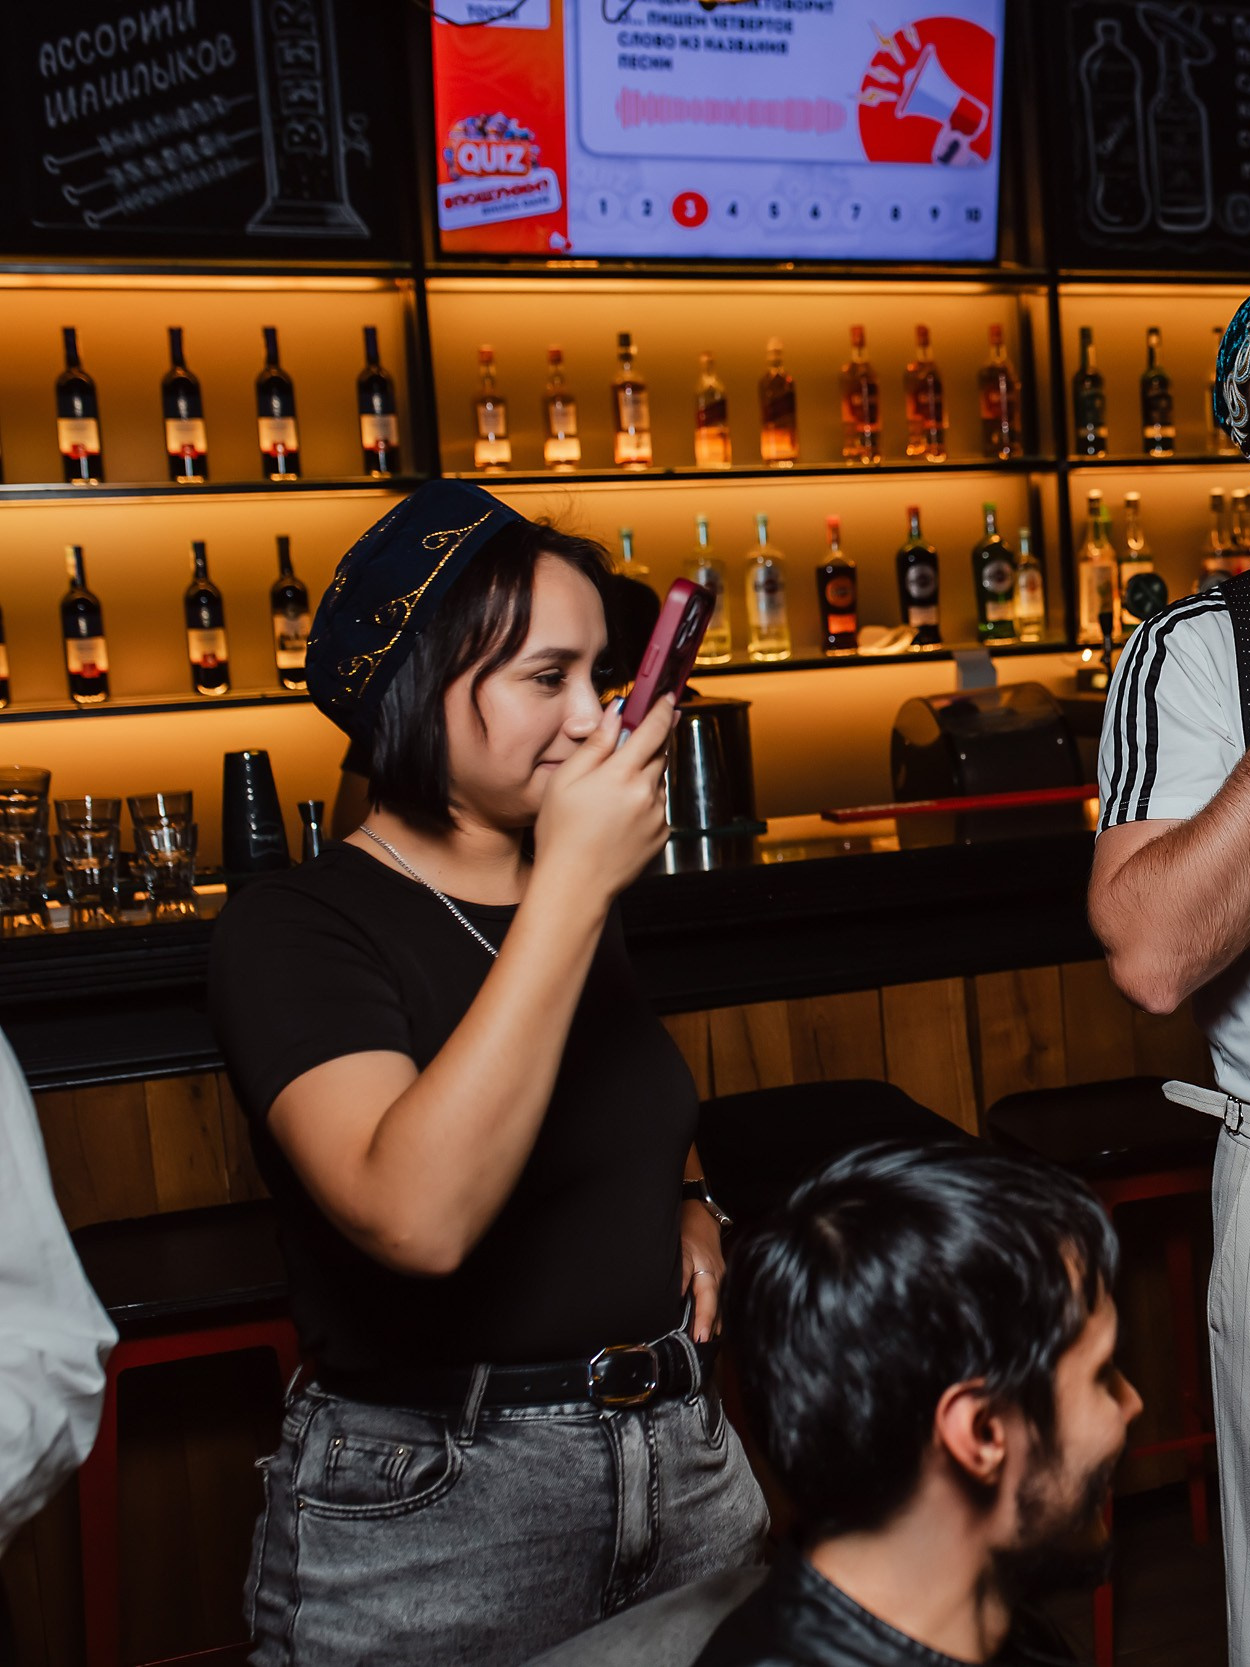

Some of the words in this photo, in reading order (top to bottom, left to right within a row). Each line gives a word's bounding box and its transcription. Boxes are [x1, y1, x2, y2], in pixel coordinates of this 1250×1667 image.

[647, 11, 708, 28] ПИШЕМ
[617, 31, 676, 49] СЛОВО
[679, 35, 700, 51] ИЗ
[618, 54, 673, 71] ПЕСНИ
[44, 33, 236, 128] ШАШЛЫКОВ
[458, 143, 525, 173] QUIZ
